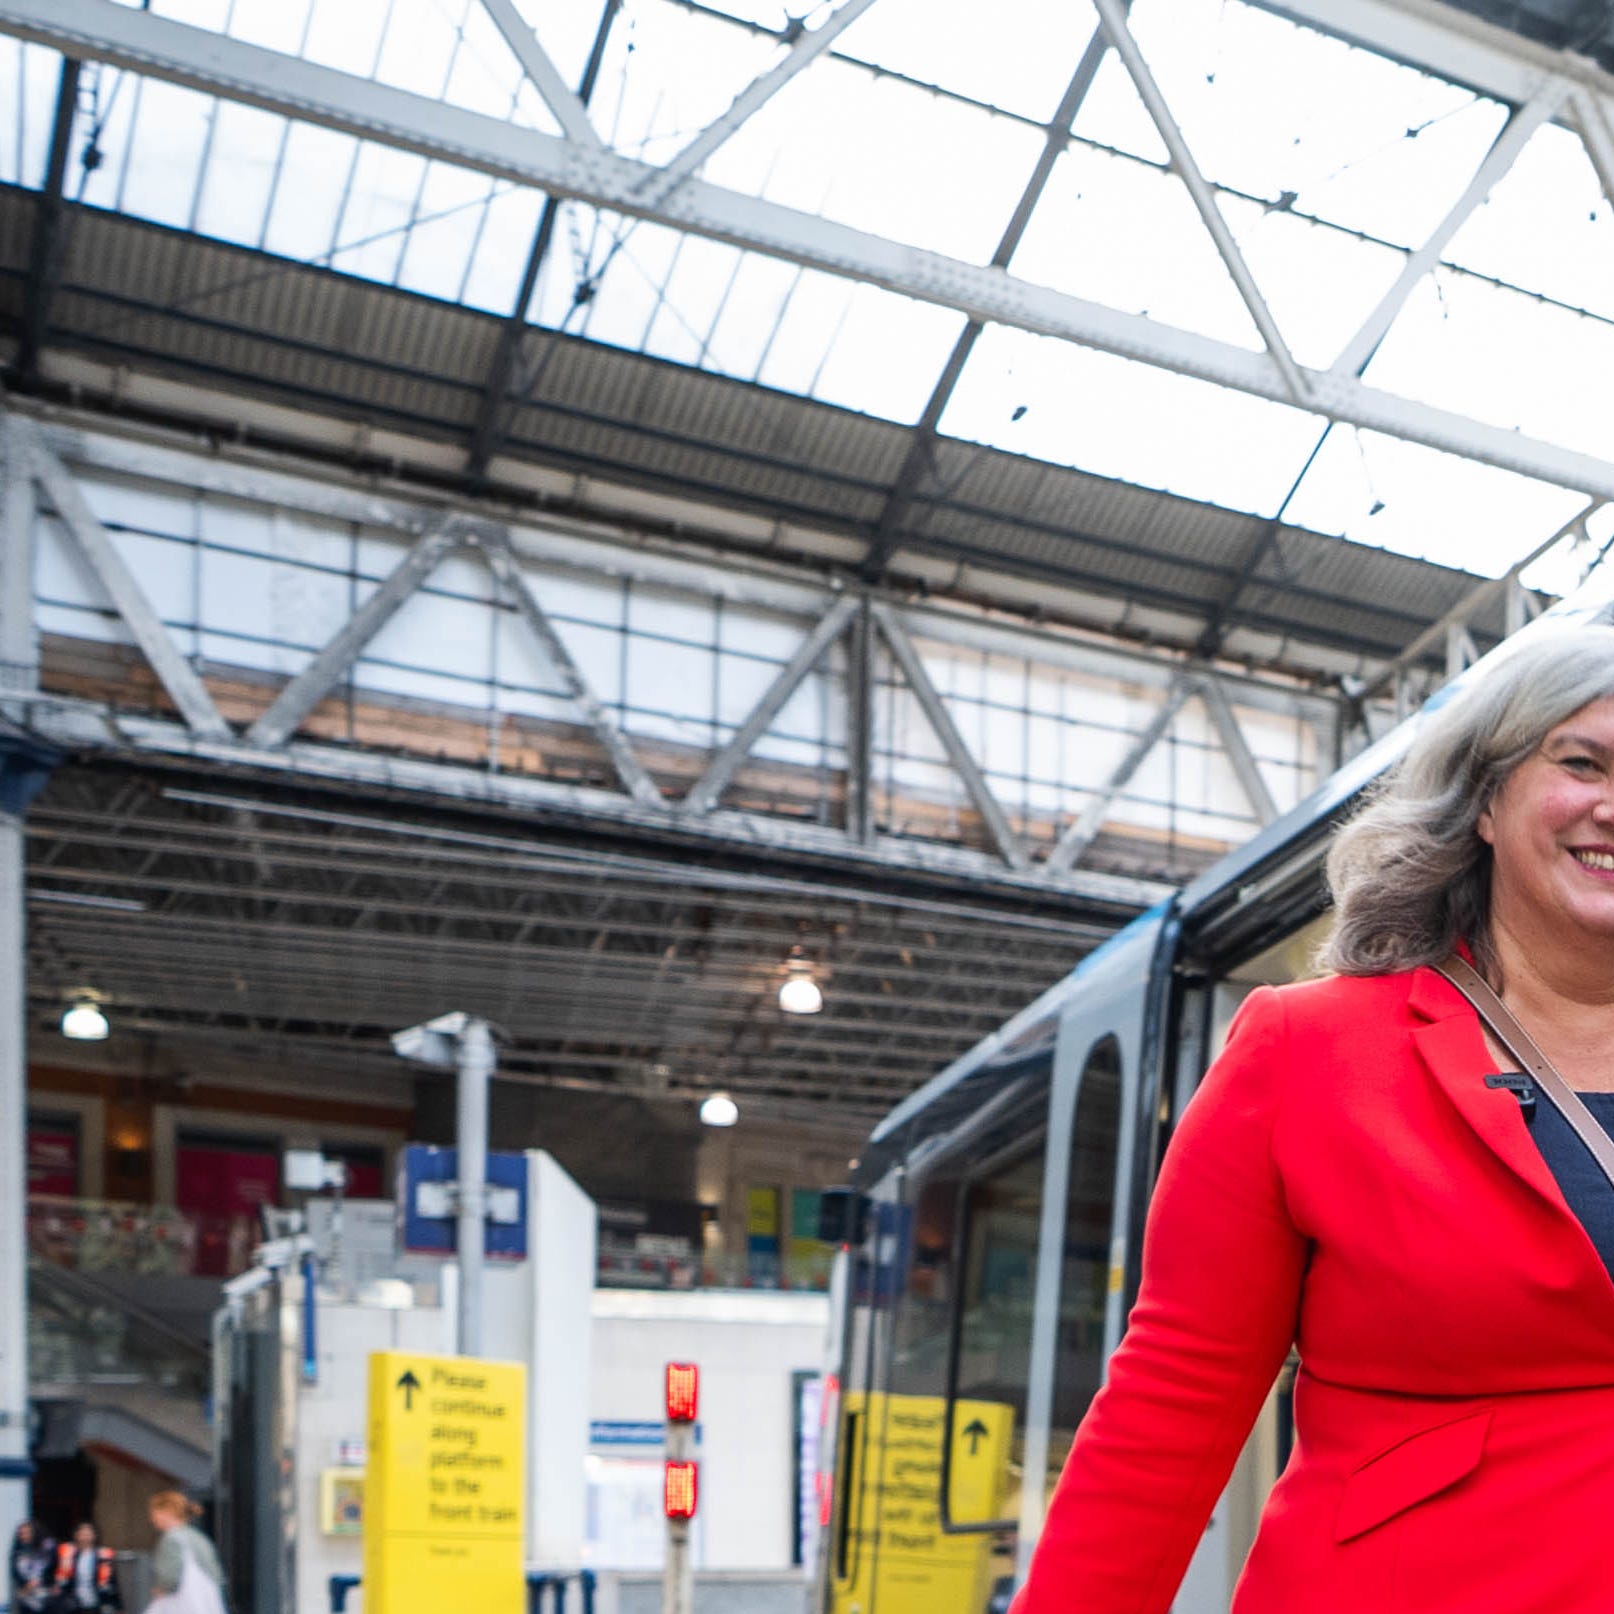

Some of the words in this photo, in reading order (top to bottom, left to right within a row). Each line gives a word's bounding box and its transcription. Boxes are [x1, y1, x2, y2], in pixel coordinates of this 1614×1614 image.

[431, 1366, 487, 1390] Please
[431, 1397, 508, 1419] continue
[431, 1424, 479, 1446] along
[430, 1449, 504, 1470] platform
[430, 1477, 447, 1493] to
[454, 1477, 481, 1494] the
[428, 1502, 473, 1522] front
[479, 1504, 518, 1522] train
